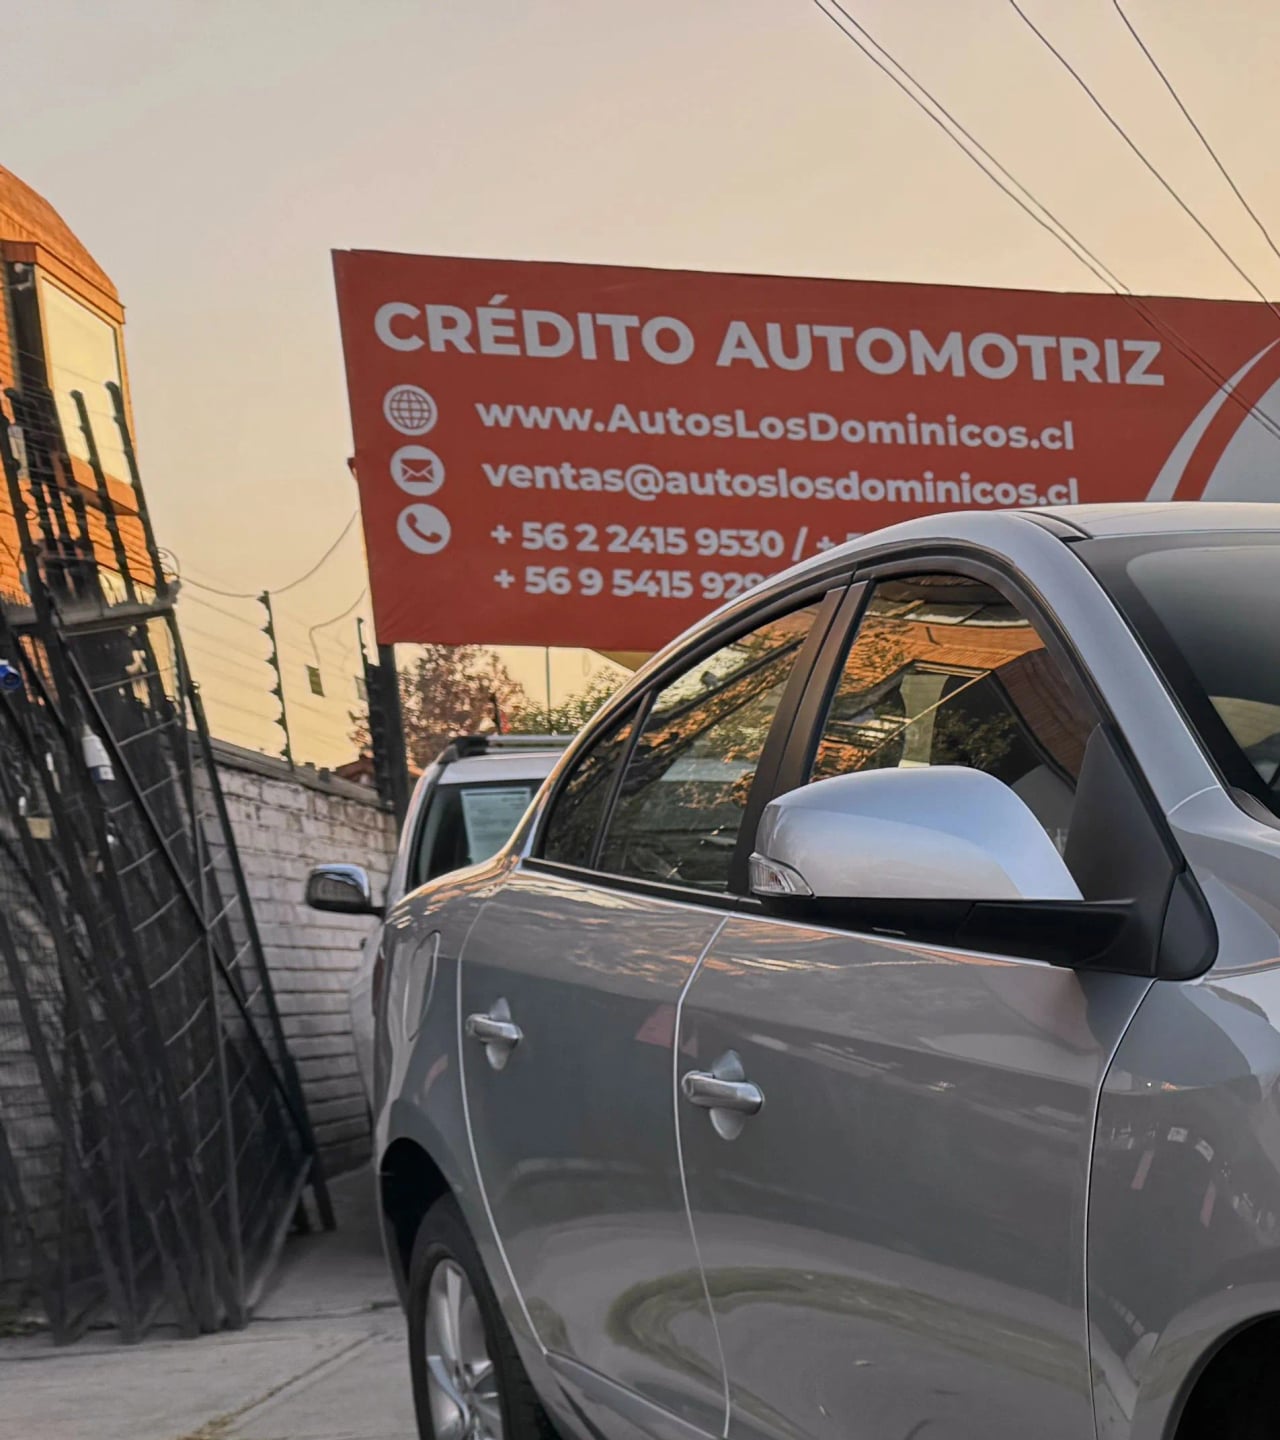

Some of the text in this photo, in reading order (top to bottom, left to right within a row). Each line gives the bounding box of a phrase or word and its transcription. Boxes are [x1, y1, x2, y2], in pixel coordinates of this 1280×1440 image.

[374, 294, 1164, 386] CRÉDITO AUTOMOTRIZ
[475, 403, 1075, 450] www.AutosLosDominicos.cl
[481, 462, 1079, 505] ventas@autoslosdominicos.cl
[522, 521, 569, 551] 56
[574, 523, 600, 552] 2
[605, 525, 688, 555] 2415
[695, 528, 785, 558] 9530
[525, 566, 571, 596] 56
[578, 568, 603, 597] 9
[612, 569, 693, 599] 5415
[701, 571, 775, 600] 929
